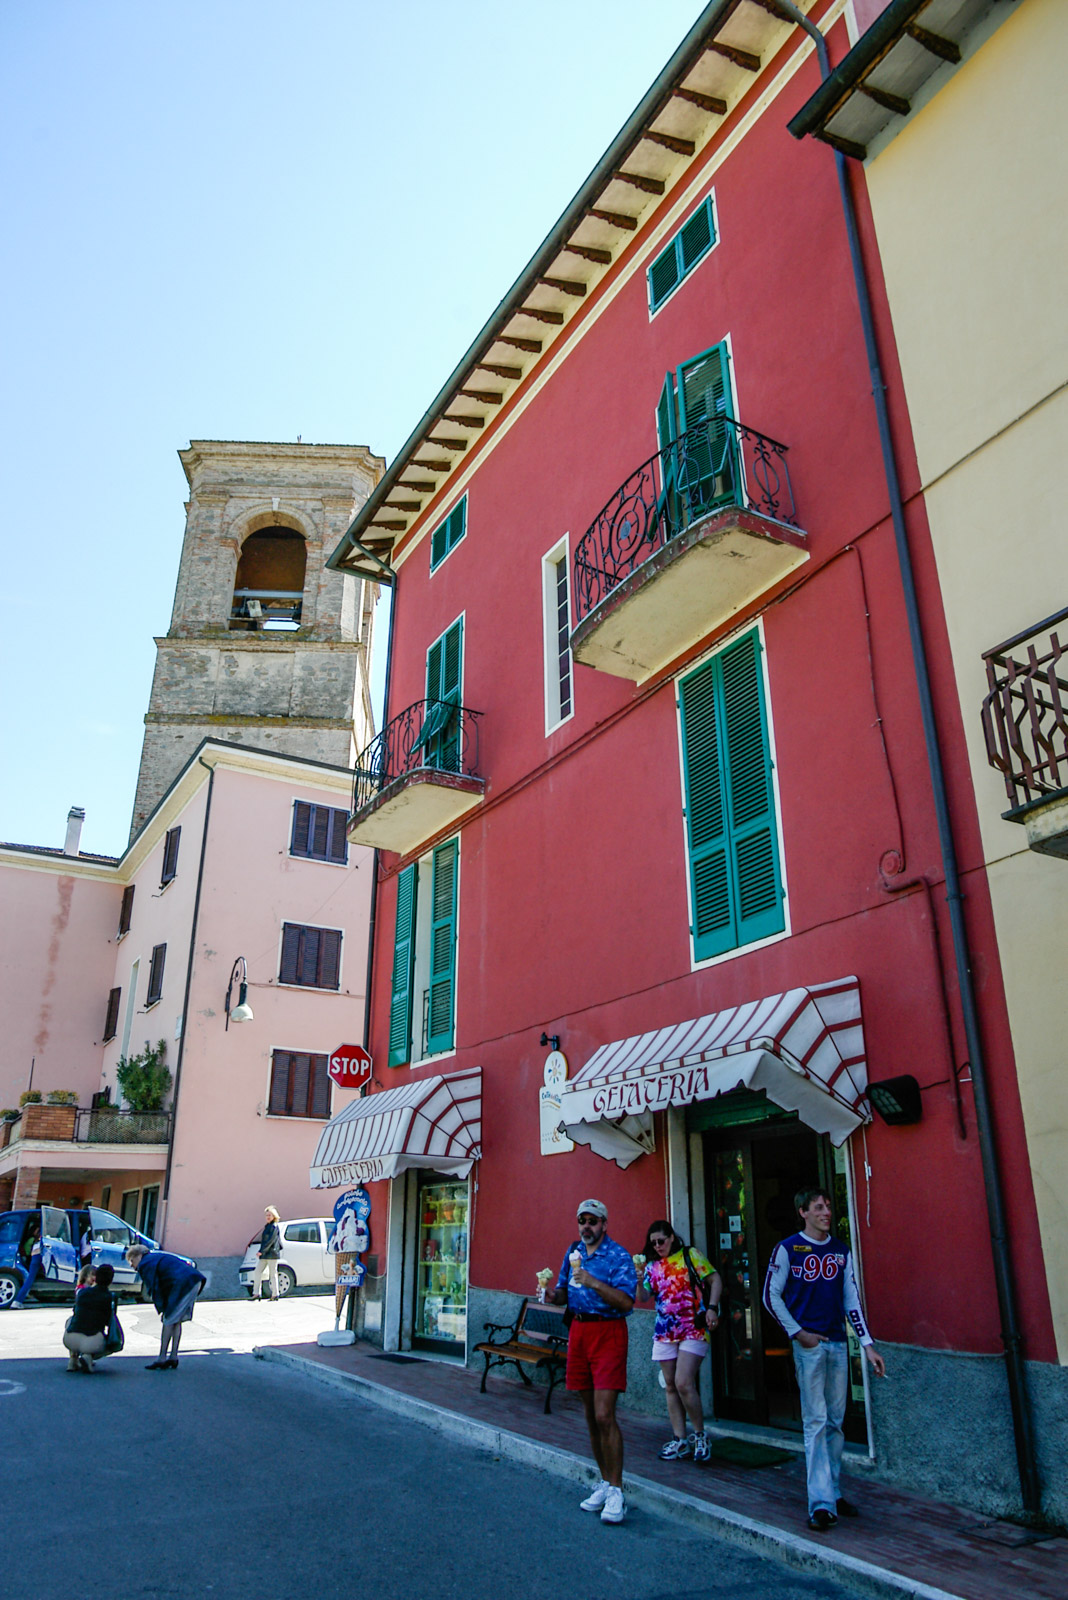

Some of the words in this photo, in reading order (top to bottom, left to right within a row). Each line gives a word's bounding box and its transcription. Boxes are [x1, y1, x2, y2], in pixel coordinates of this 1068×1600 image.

[331, 1057, 369, 1076] STOP
[593, 1067, 709, 1113] GELATERIA
[321, 1159, 383, 1184] CAFFETTERIA
[803, 1253, 838, 1282] 96
